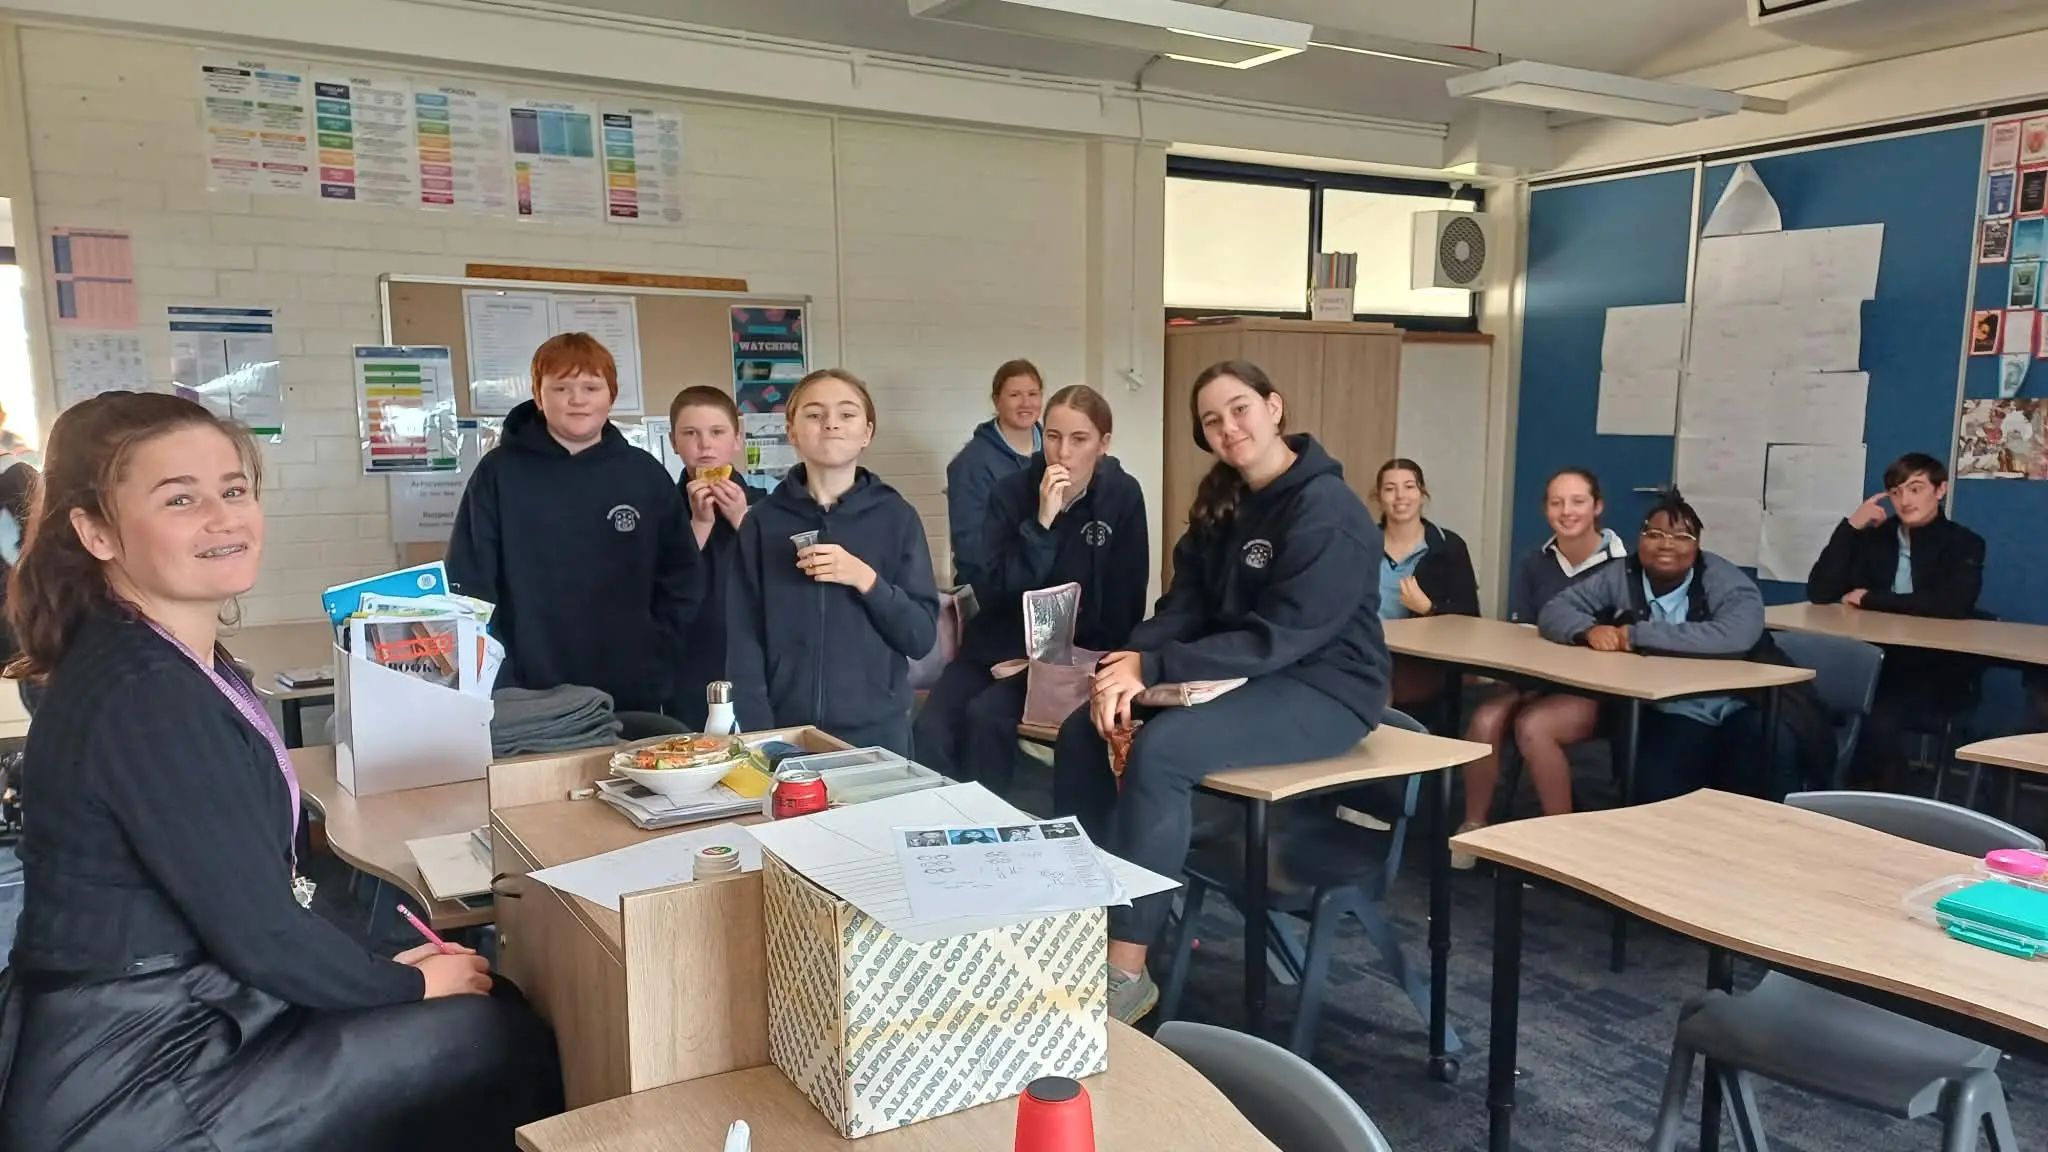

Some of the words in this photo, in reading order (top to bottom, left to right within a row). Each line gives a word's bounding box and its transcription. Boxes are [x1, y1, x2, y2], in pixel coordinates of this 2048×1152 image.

[740, 341, 799, 352] WATCHING
[856, 933, 903, 992] LASER
[1038, 911, 1081, 973] ALPINE
[1052, 922, 1095, 985] ALPINE
[1065, 936, 1107, 997] ALPINE
[871, 947, 918, 1005] LASER
[886, 961, 932, 1018] LASER
[854, 1029, 905, 1097] ALPINE
[901, 974, 946, 1031] LASER
[869, 1042, 920, 1109] ALPINE
[915, 987, 961, 1044] LASER
[958, 938, 992, 985] COPY
[884, 1054, 934, 1121] ALPINE
[930, 1000, 975, 1056] LASER
[972, 951, 1006, 998] COPY
[944, 1012, 989, 1068] LASER
[986, 963, 1020, 1010] COPY
[959, 1024, 1003, 1079] LASER
[1000, 976, 1033, 1023] COPY
[972, 1037, 1017, 1092] LASER
[1014, 988, 1047, 1035] COPY
[1027, 1001, 1060, 1048] COPY
[1040, 1013, 1073, 1060] COPY
[1053, 1026, 1086, 1072] COPY
